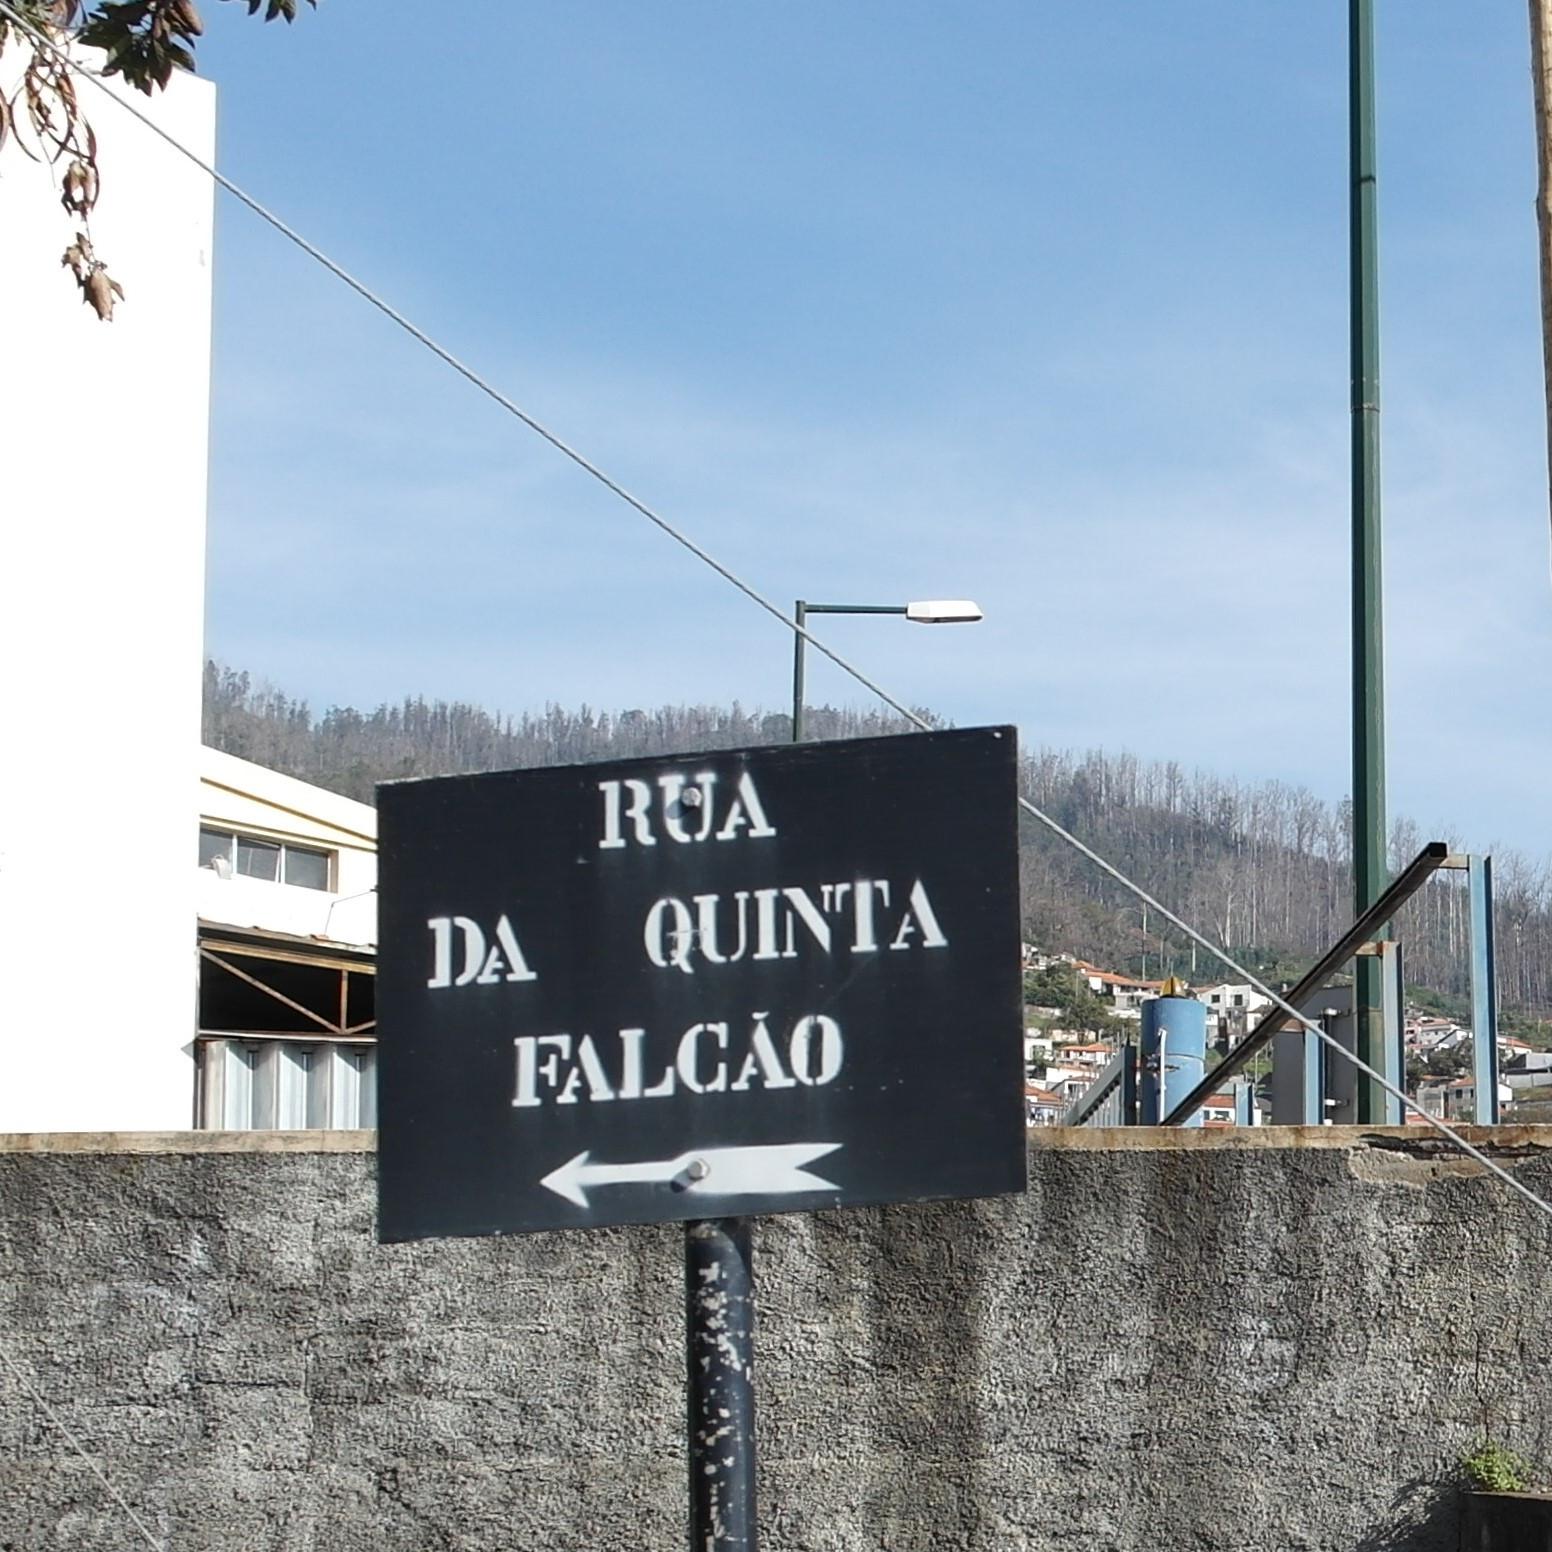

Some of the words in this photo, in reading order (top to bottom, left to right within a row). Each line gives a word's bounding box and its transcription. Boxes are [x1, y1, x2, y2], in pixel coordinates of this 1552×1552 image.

[598, 770, 777, 850] RUA
[427, 913, 538, 989] DA
[644, 878, 949, 974] QUINTA
[511, 1011, 845, 1108] FALCÃO
